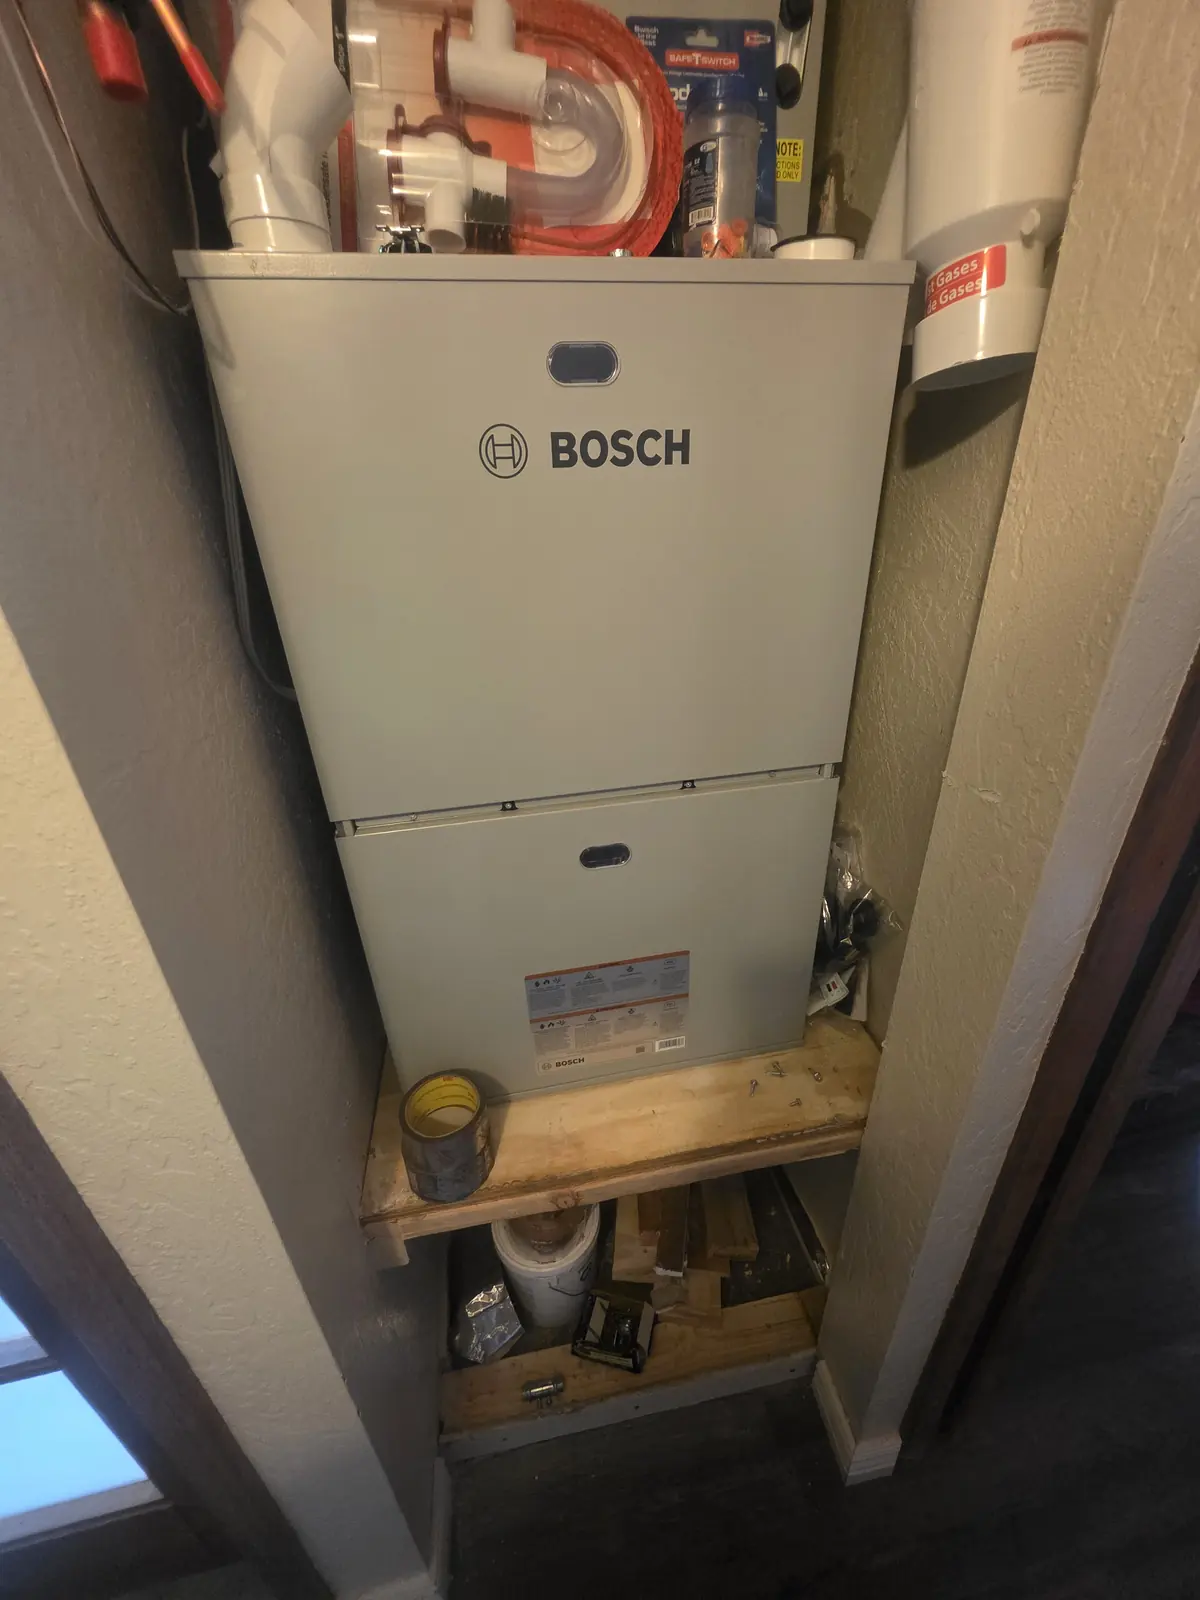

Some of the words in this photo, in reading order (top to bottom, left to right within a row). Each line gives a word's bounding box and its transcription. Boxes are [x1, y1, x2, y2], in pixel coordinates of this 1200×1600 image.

[782, 170, 800, 180] ONLY
[936, 259, 978, 288] Gases
[939, 277, 983, 305] Gases
[550, 429, 690, 468] BOSCH
[555, 1057, 585, 1068] BOSCH
